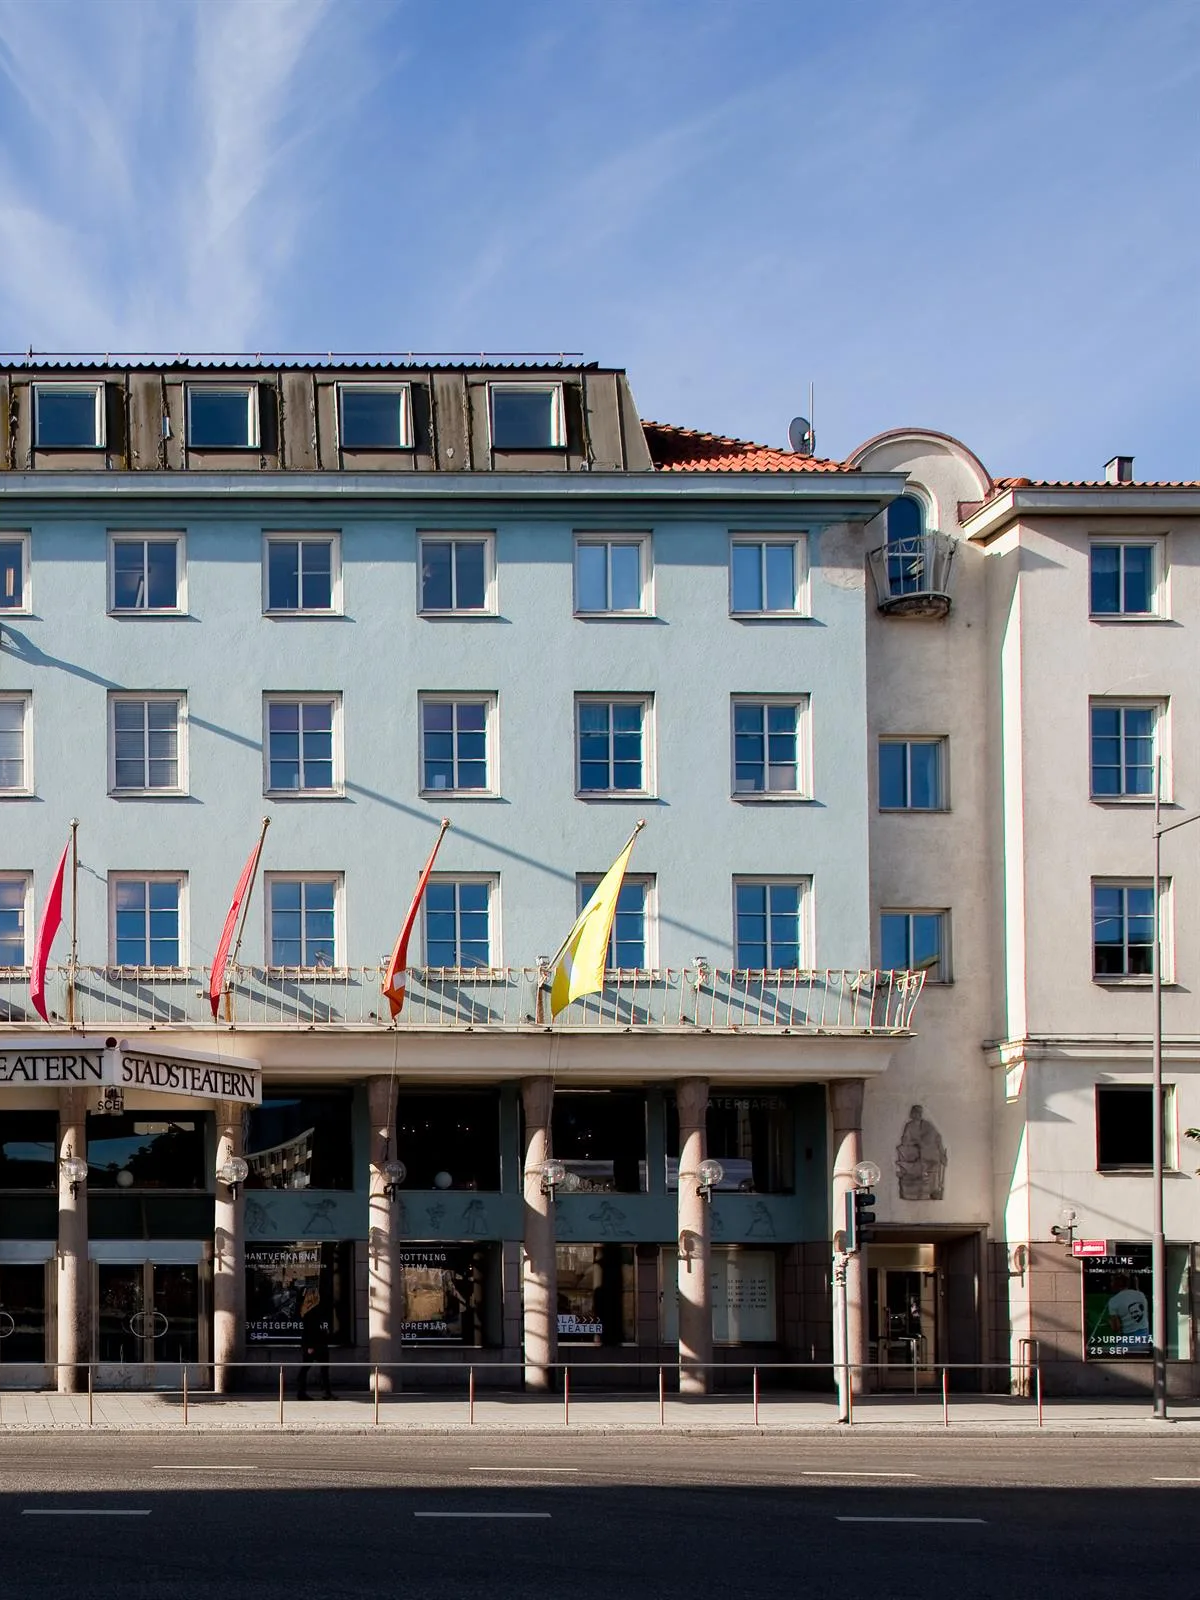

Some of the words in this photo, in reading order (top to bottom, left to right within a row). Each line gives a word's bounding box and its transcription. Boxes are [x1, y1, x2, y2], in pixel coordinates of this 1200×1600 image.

[122, 1057, 255, 1098] STADSTEATERN
[1090, 1346, 1103, 1355] 25
[1109, 1346, 1129, 1355] SEP
